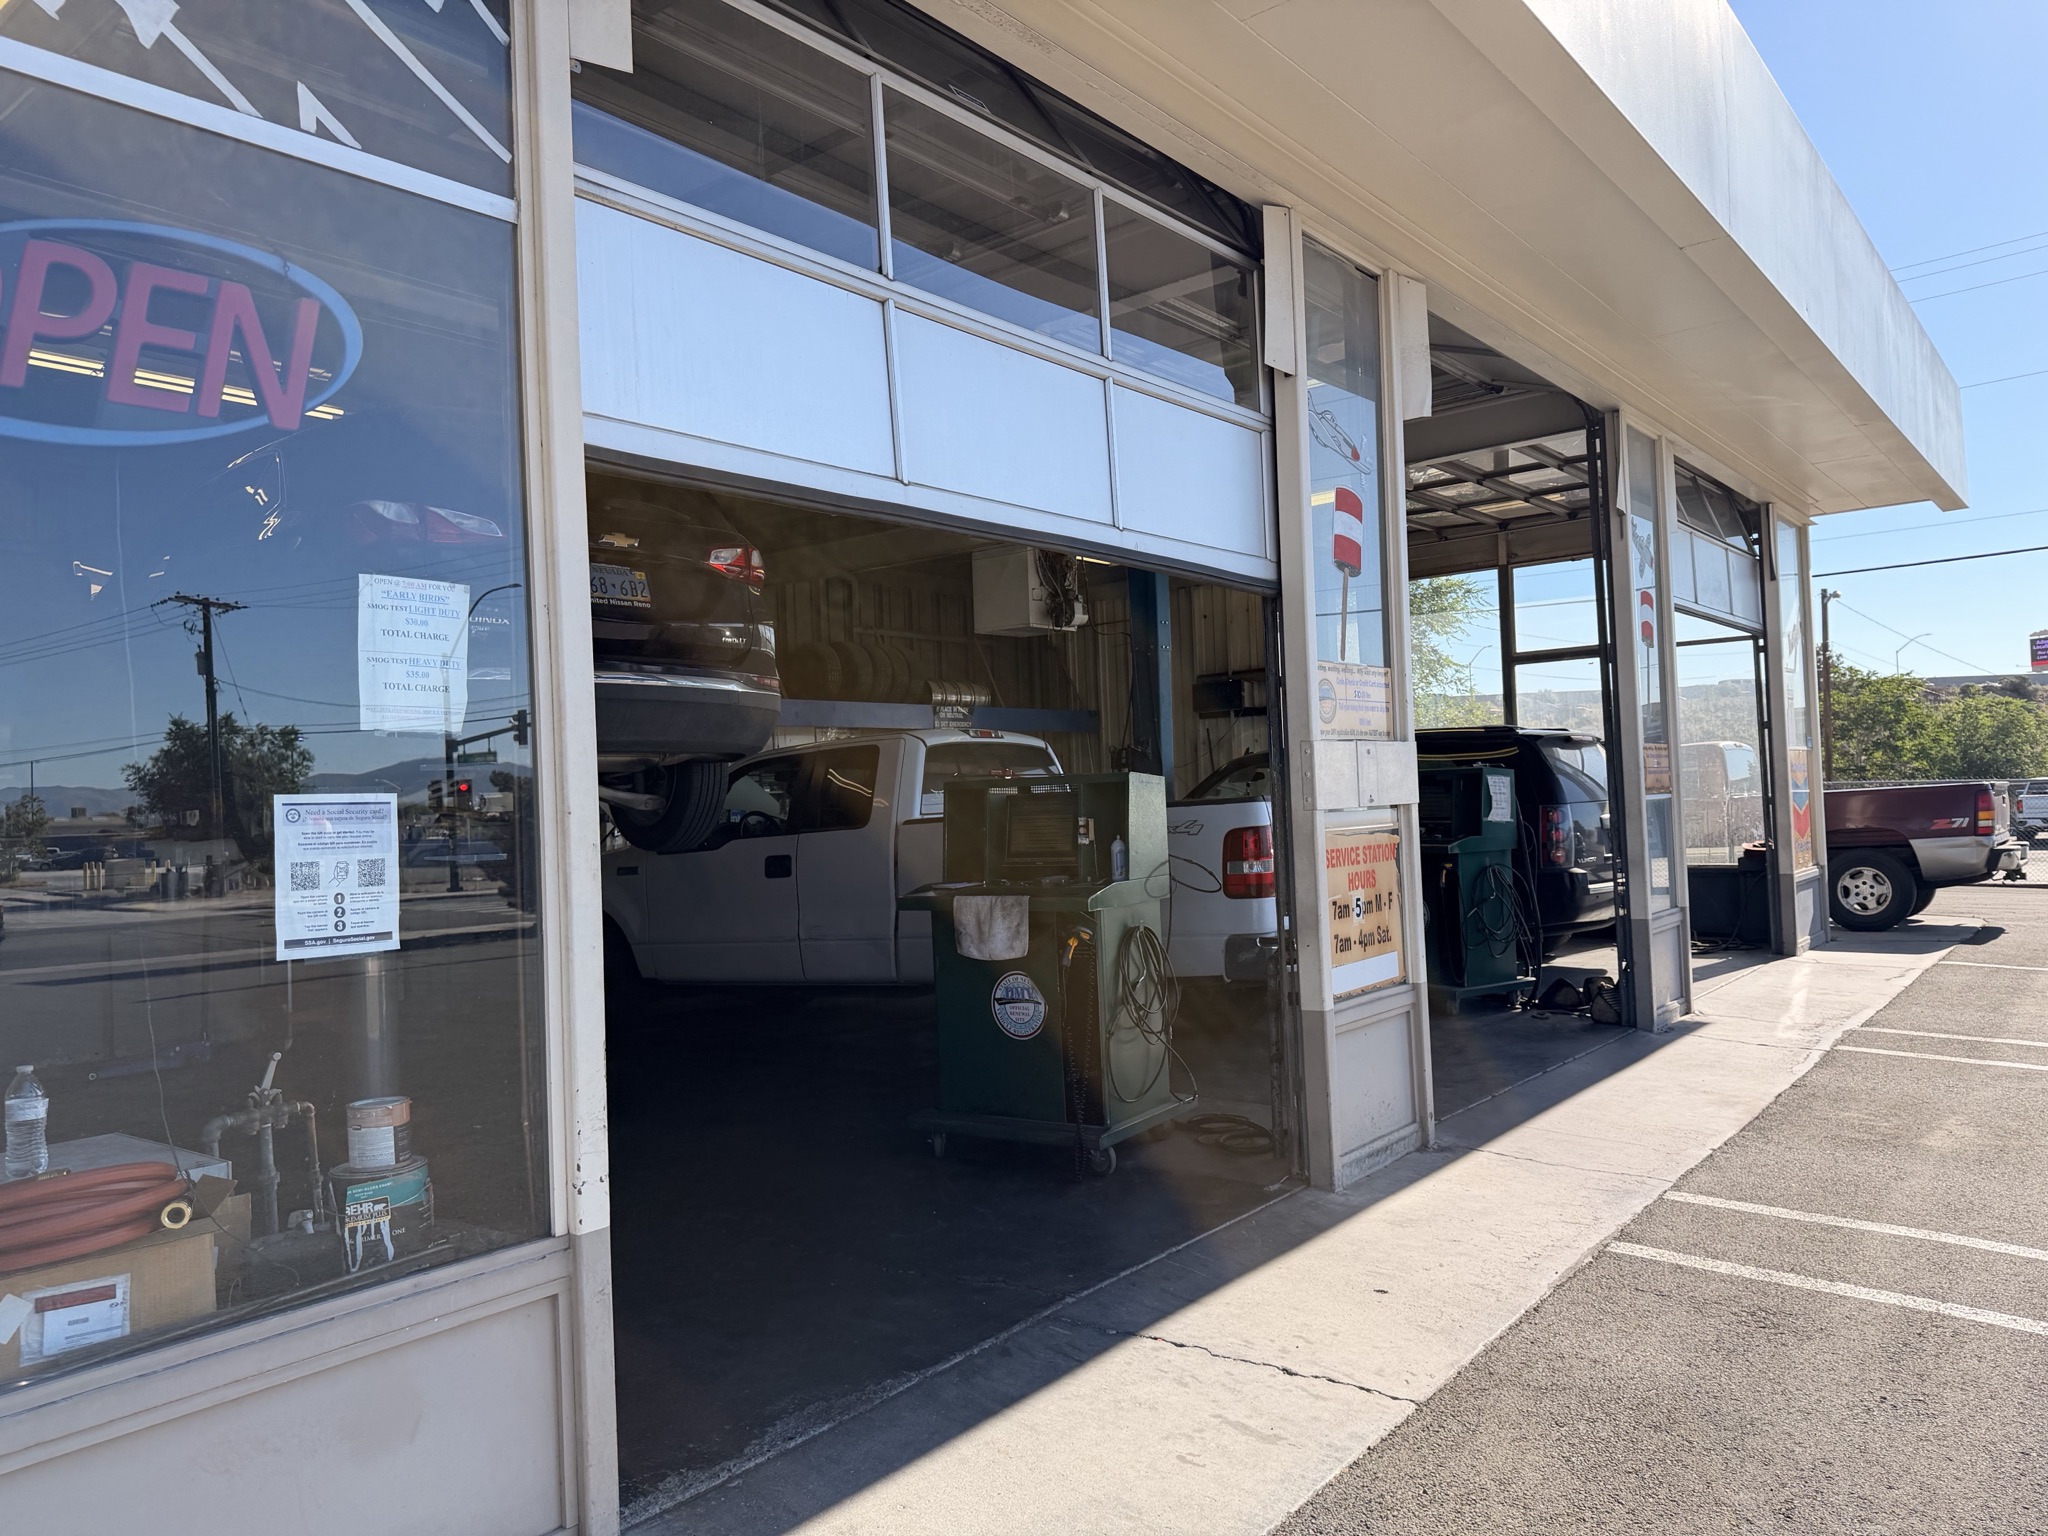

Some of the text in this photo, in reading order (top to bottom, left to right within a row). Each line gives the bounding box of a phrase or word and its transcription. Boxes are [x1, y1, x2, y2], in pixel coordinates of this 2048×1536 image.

[0, 239, 320, 431] PEN
[592, 567, 630, 577] NEVADA
[374, 577, 392, 586] OPEN
[393, 580, 401, 588] @
[415, 582, 427, 591] AM
[428, 583, 442, 591] FOR
[591, 577, 608, 595] 68
[590, 597, 608, 605] nited
[609, 599, 633, 607] Nissan
[367, 603, 461, 619] SMOG TEST LIGHT DUTY
[405, 617, 429, 627] $30.00
[380, 628, 450, 642] TOTAL CHARGE
[367, 656, 389, 665] SMOG
[391, 657, 408, 665] TEST
[408, 657, 438, 668] HEAVY
[405, 670, 430, 680] $35.00
[382, 681, 451, 694] TOTAL CHARGE
[345, 808, 369, 816] Security
[369, 807, 385, 815] card?
[1168, 820, 1204, 835] x4
[1931, 817, 1970, 830] Z71
[1325, 842, 1396, 869] SERVICE STATION
[1347, 869, 1376, 892] HOURS
[337, 907, 343, 917] 2
[1332, 900, 1350, 921] 7am
[1355, 897, 1374, 919] 5pm
[1375, 893, 1382, 913] M
[1388, 891, 1393, 910] F
[337, 921, 343, 931] 3
[332, 936, 376, 944] SeguroSocial.gov
[1333, 933, 1352, 954] 7am
[1358, 928, 1375, 952] 4pm
[1376, 925, 1392, 945] Sat.
[998, 977, 1011, 991] STATE
[1020, 976, 1031, 985] NEV
[1012, 1010, 1043, 1035] REGISTRATION
[345, 1202, 374, 1217] BEHR
